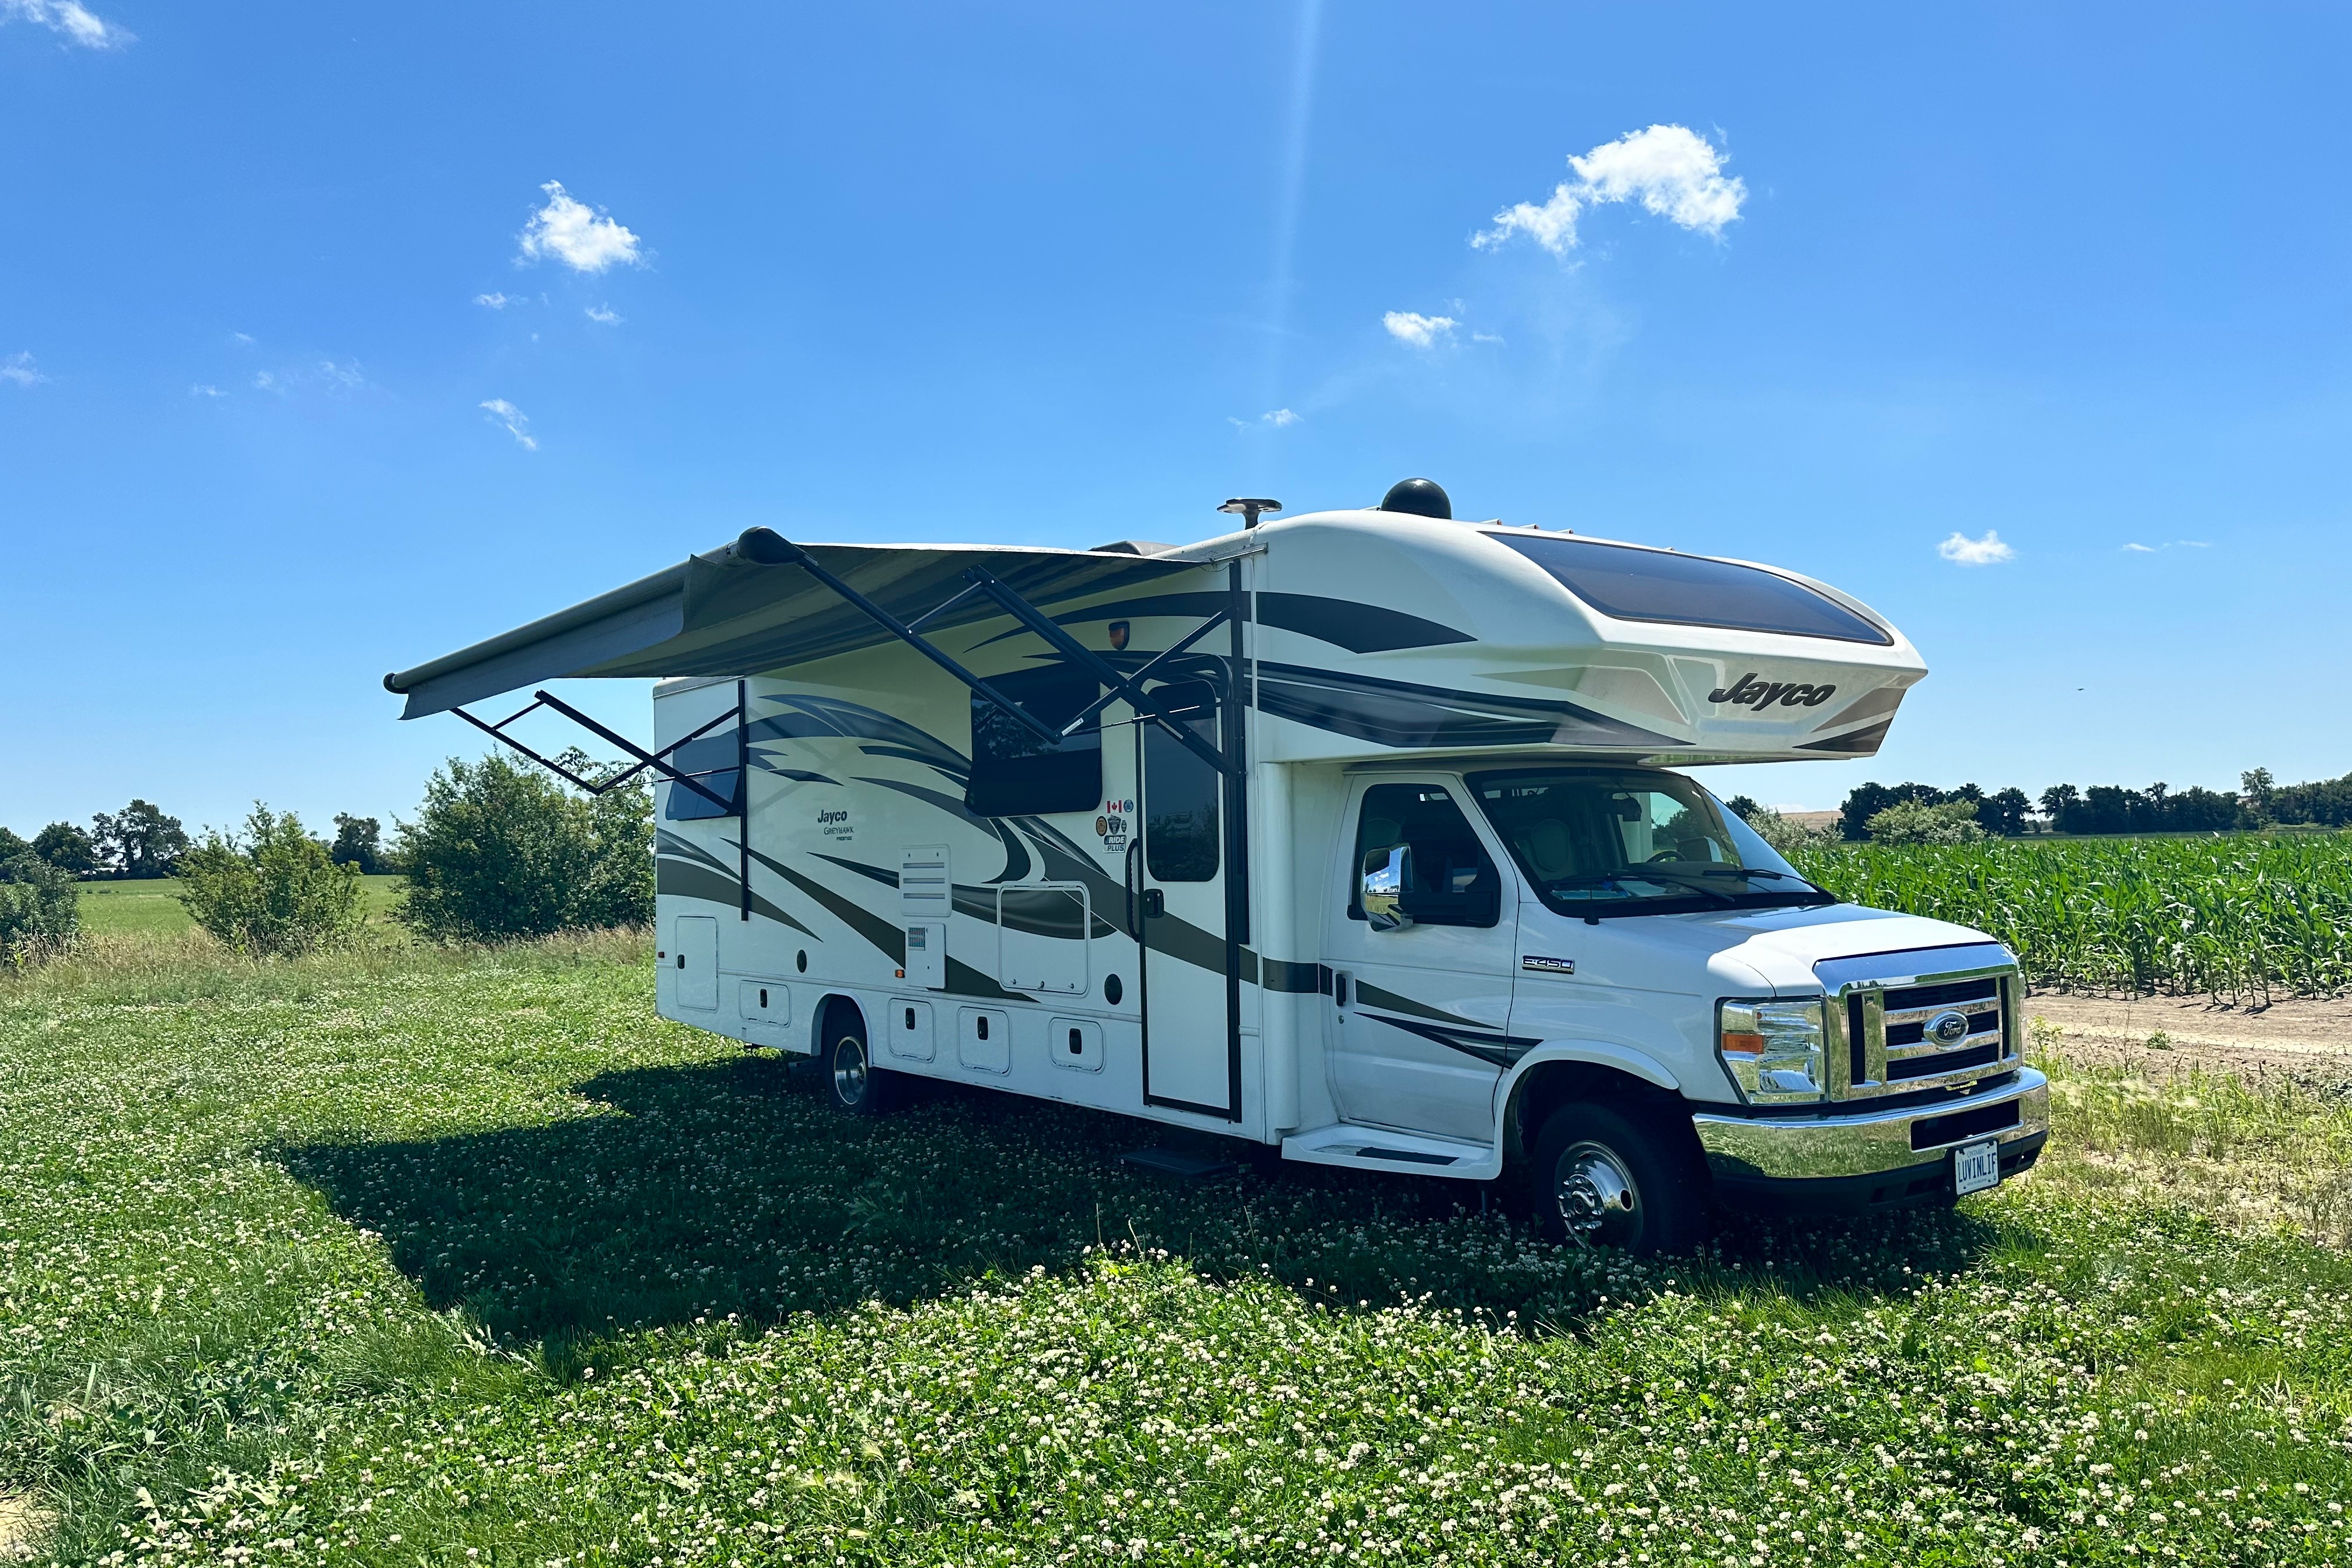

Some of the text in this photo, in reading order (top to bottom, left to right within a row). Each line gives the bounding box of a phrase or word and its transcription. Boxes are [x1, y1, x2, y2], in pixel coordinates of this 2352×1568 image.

[1708, 673, 1836, 711] Jayco
[817, 809, 847, 825] Jayco
[824, 827, 854, 835] GREYHAWK
[1944, 1021, 1961, 1037] Ford
[1958, 1152, 1996, 1183] LUVINLIF
